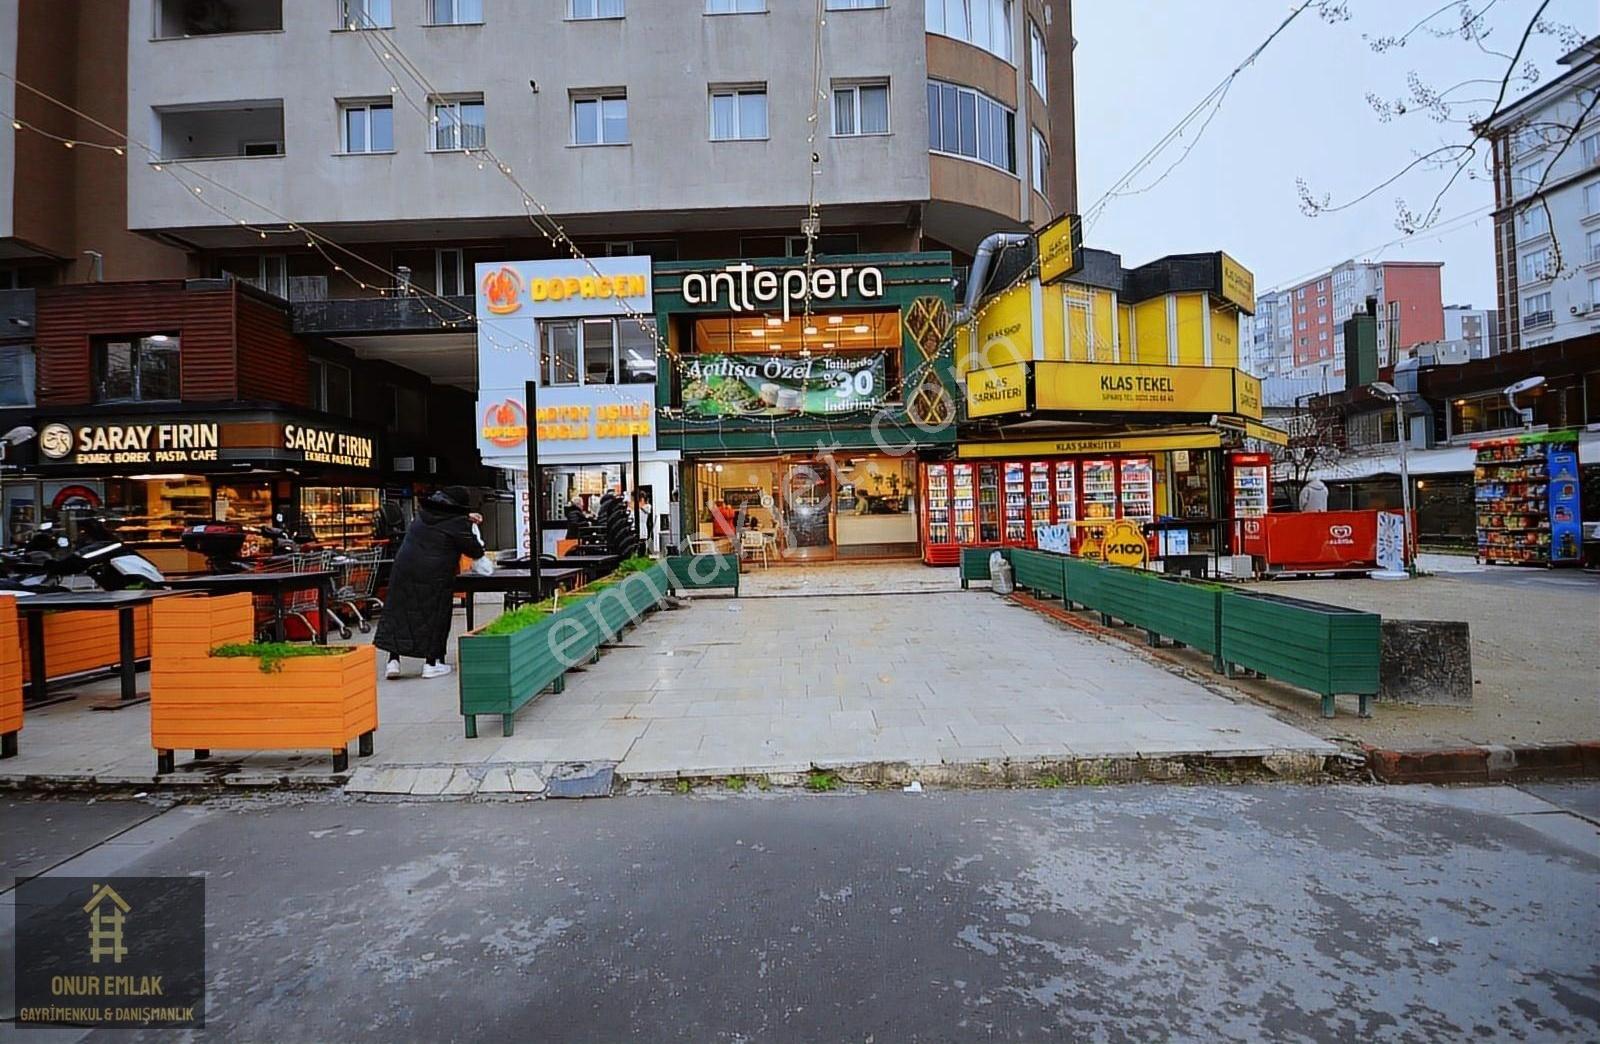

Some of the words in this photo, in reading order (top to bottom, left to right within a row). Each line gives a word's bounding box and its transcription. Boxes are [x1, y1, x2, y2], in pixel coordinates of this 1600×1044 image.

[683, 262, 883, 322] antepera
[763, 358, 812, 379] Özel
[823, 371, 873, 397] %30
[1100, 376, 1133, 391] KLAS
[1135, 377, 1174, 392] TEKEL
[80, 426, 152, 451] SARAY
[159, 424, 218, 448] FIRIN
[285, 424, 335, 453] SARAY
[338, 433, 372, 458] FIRIN
[77, 453, 112, 464] EKMEK
[155, 451, 188, 462] PASTA
[191, 450, 217, 460] CAFE
[331, 454, 352, 465] PASTA
[1107, 543, 1143, 555] %100
